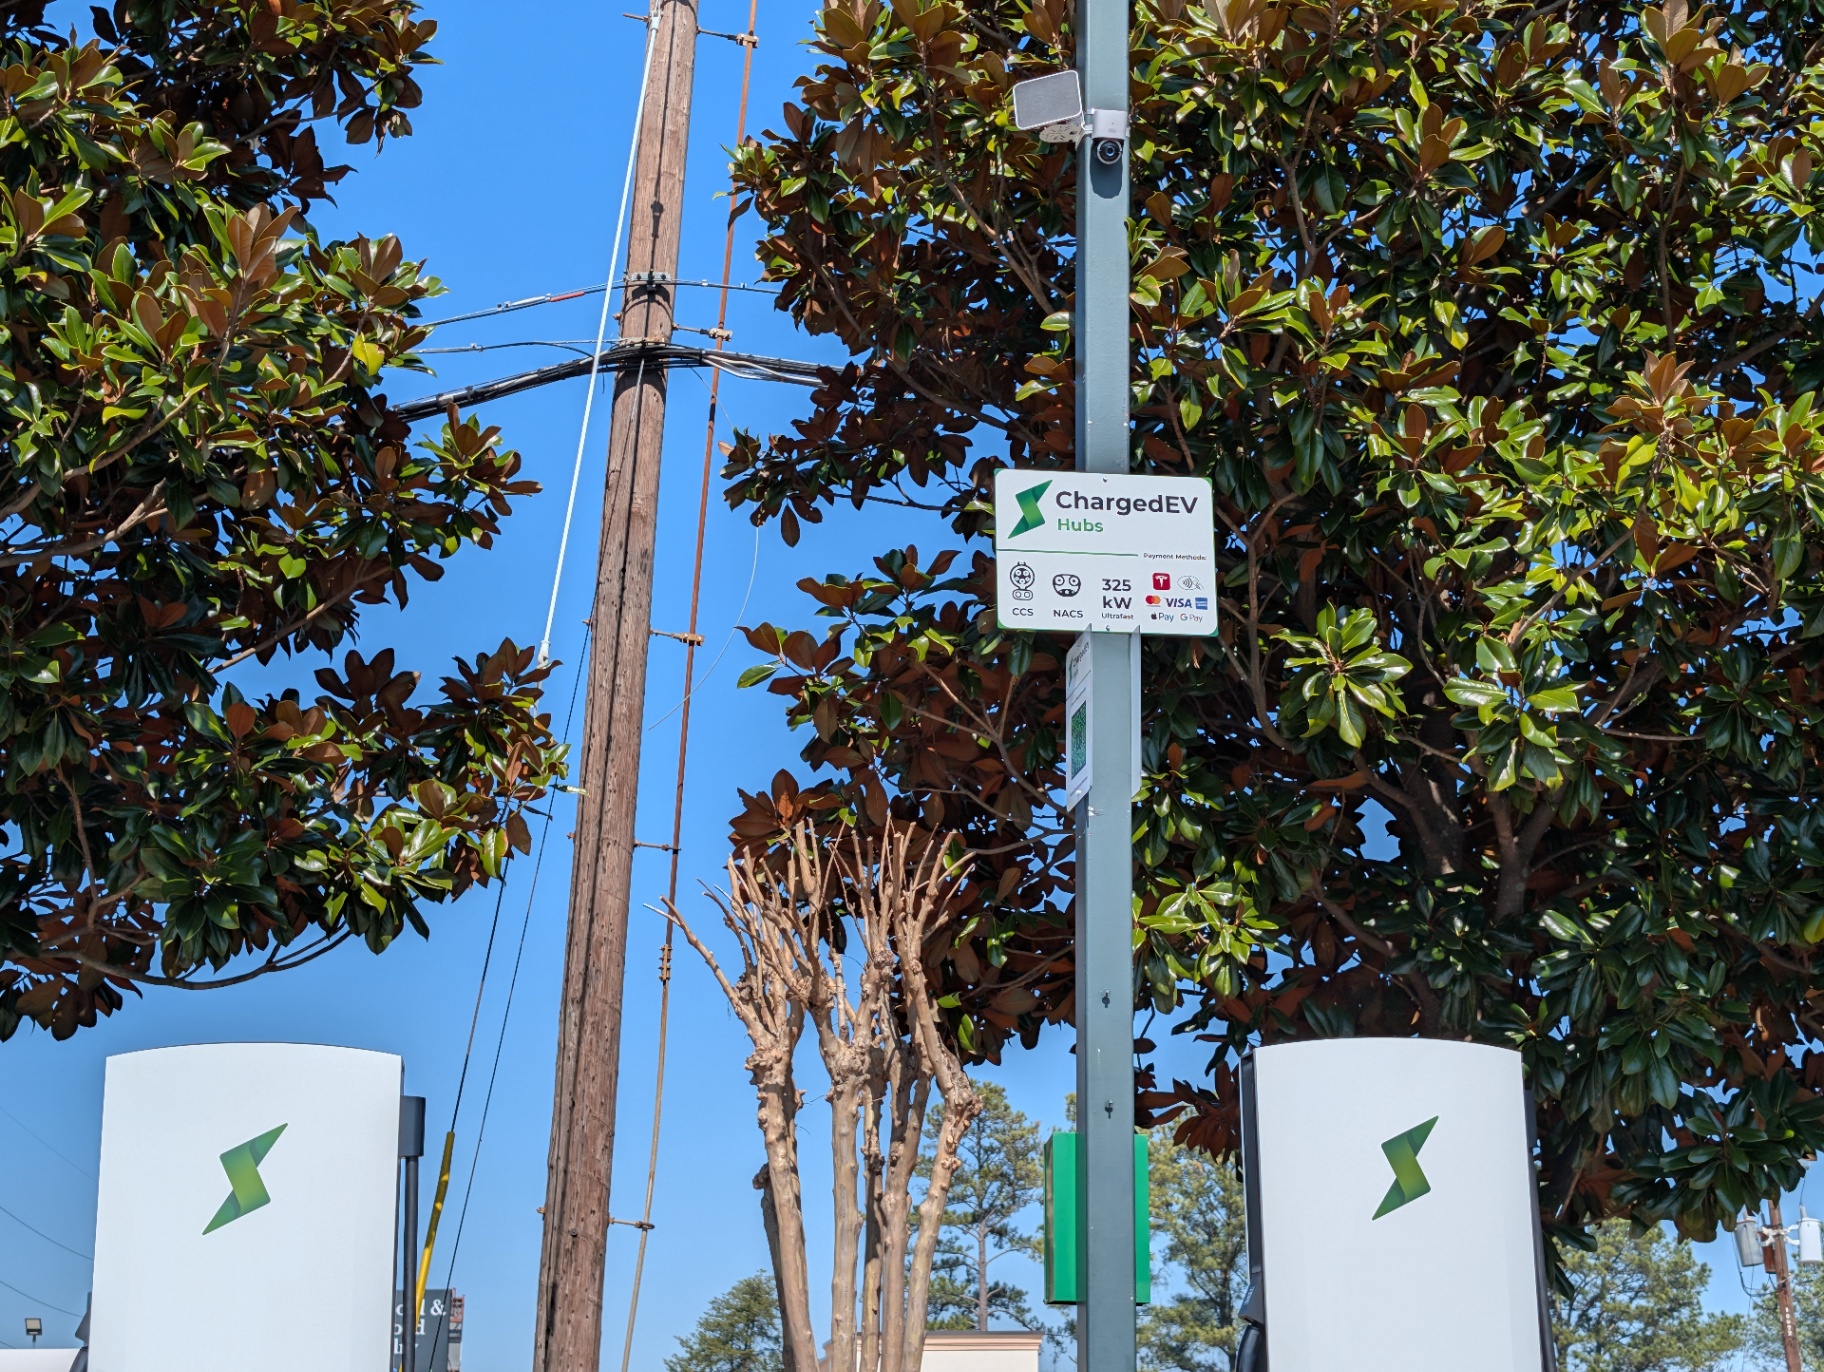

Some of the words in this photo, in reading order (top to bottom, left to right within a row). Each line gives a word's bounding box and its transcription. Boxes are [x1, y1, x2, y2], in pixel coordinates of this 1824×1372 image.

[1055, 490, 1199, 516] ChargedEV
[1057, 518, 1104, 533] Hubs
[1143, 552, 1174, 561] Payment
[1102, 578, 1132, 592] 325
[1102, 595, 1132, 610] kW
[1165, 597, 1193, 609] VISA
[1012, 607, 1034, 617] CCS
[1053, 609, 1084, 619] NACS
[1101, 612, 1134, 620] Ultrafast
[1158, 612, 1175, 623] Pay
[1189, 614, 1204, 623] Pay
